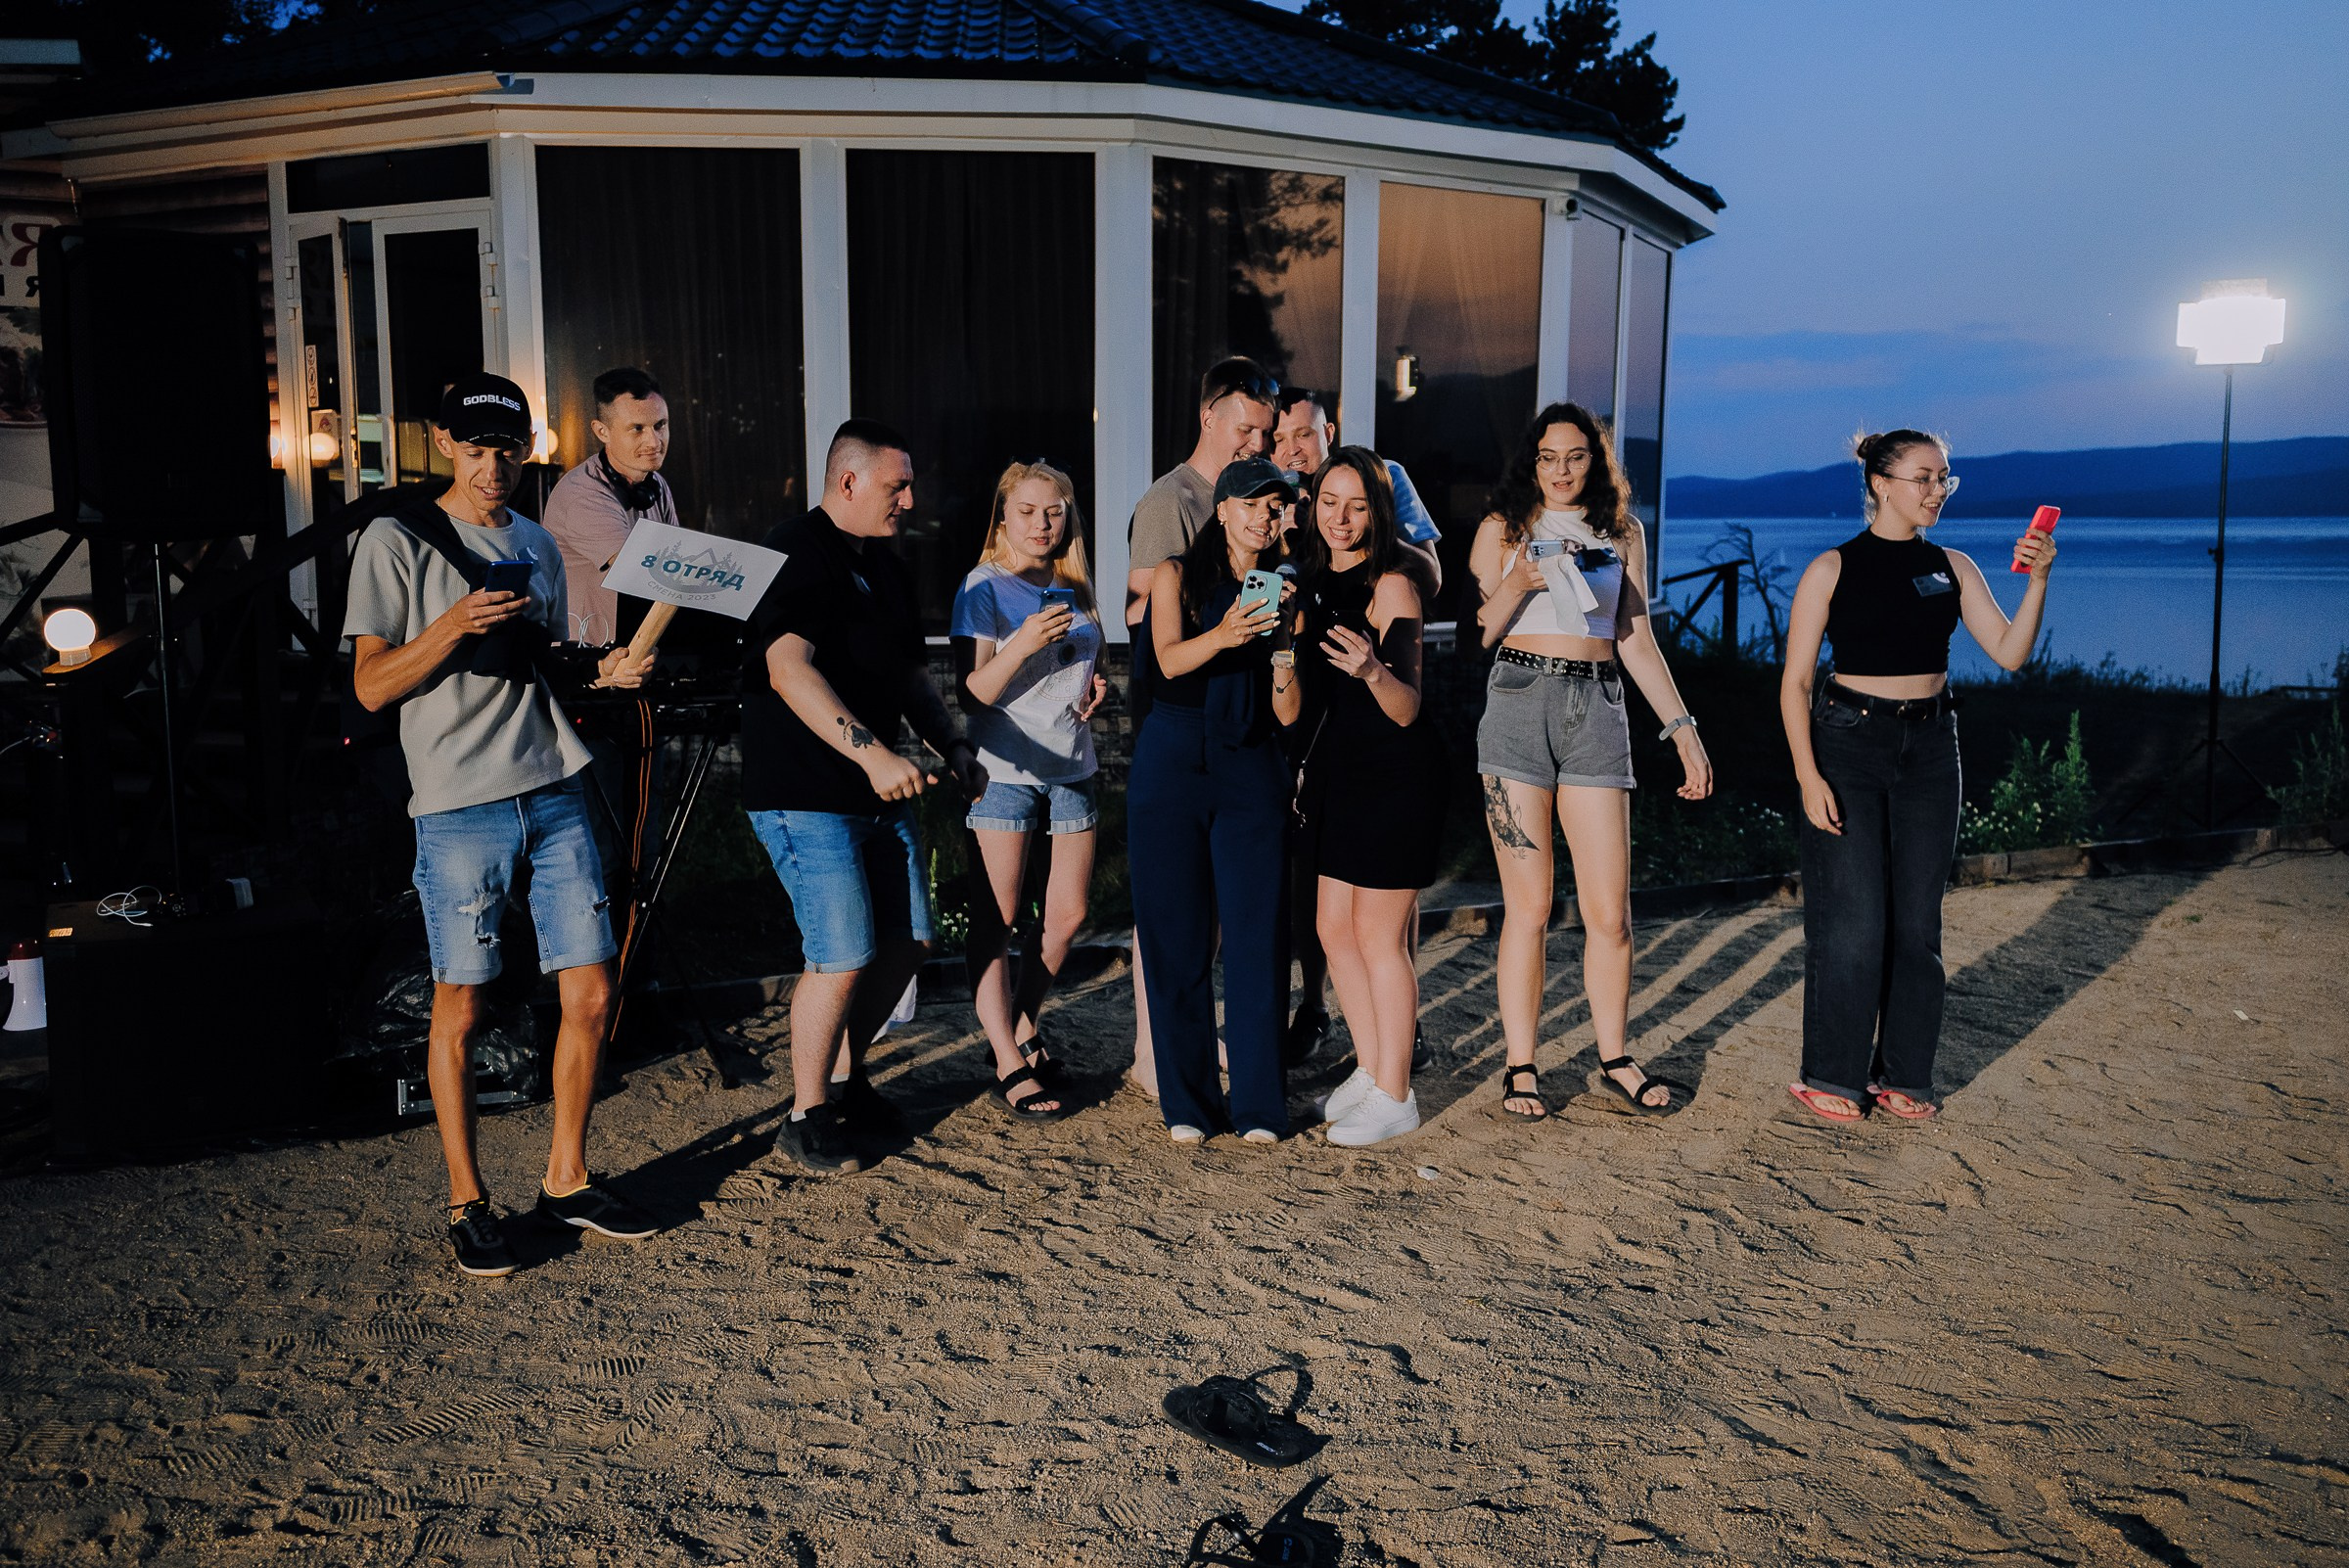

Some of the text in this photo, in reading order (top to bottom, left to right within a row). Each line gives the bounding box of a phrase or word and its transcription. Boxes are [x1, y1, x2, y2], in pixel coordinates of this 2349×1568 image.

[463, 393, 521, 411] GODBLESS
[641, 555, 745, 591] 8 ОТРЯД
[647, 580, 683, 600] СМЕНА
